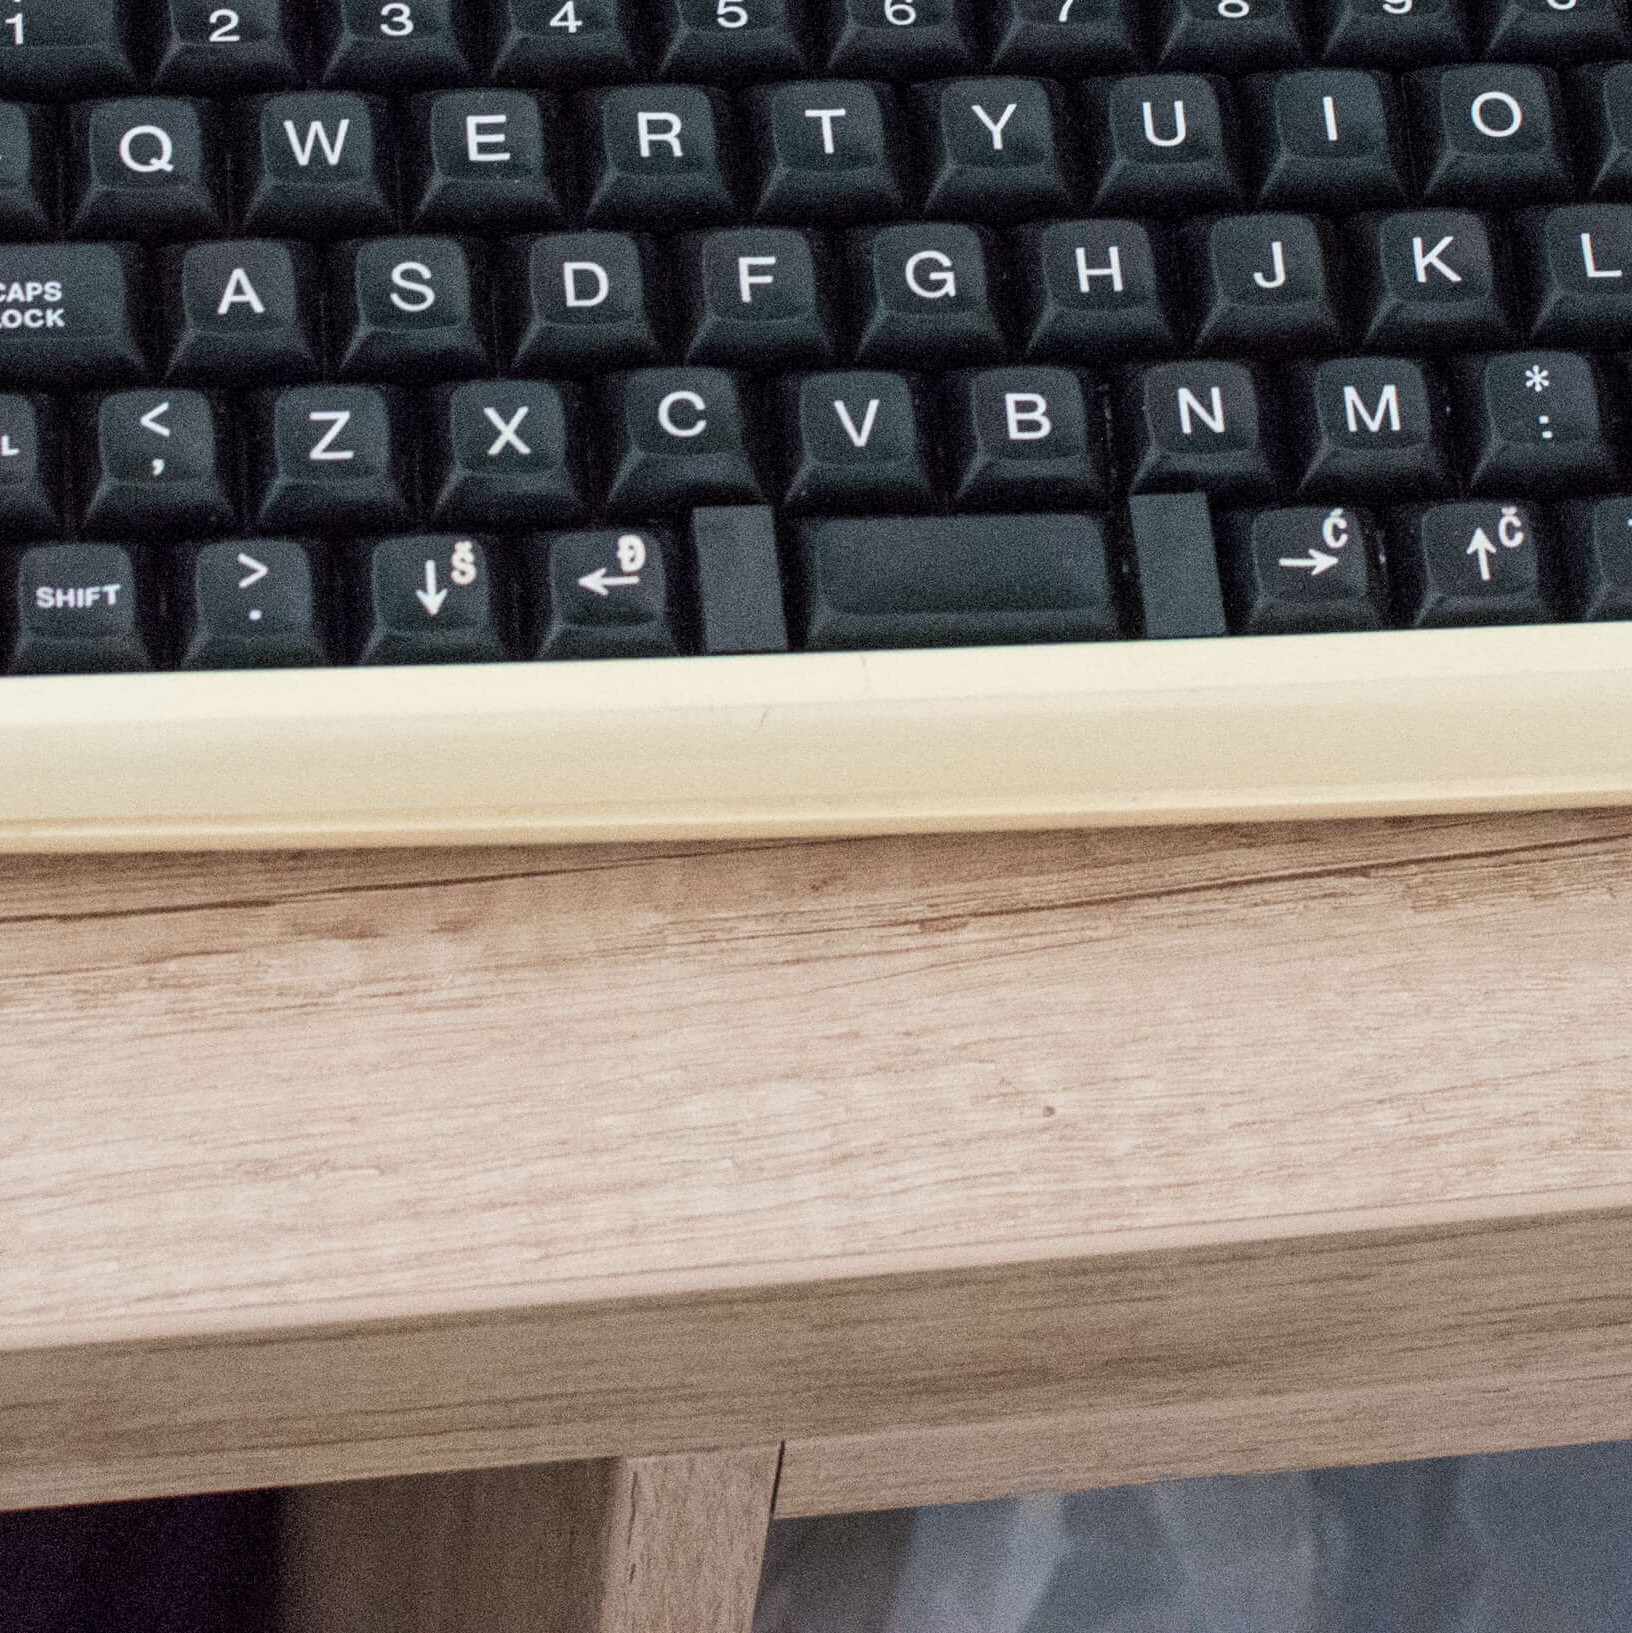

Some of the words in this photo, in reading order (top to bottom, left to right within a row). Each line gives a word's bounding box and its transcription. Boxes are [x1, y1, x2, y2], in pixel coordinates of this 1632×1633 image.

[5, 12, 24, 45] 1
[209, 8, 240, 42] 2
[380, 2, 414, 37] 3
[549, 0, 583, 33] 4
[466, 114, 511, 162] E
[637, 111, 683, 158] R
[804, 107, 847, 154] T
[971, 103, 1017, 150] Y
[1142, 100, 1187, 147] U
[1471, 90, 1523, 138] O
[119, 124, 174, 173] Q
[283, 118, 350, 166] W
[738, 255, 777, 303] F
[905, 250, 956, 299] G
[1075, 245, 1123, 293] H
[1253, 241, 1286, 289] J
[1412, 235, 1462, 283] K
[1580, 232, 1623, 278] L
[217, 267, 265, 315] A
[390, 261, 435, 312] S
[563, 261, 610, 307] D
[483, 406, 531, 455] X
[658, 390, 707, 437] C
[833, 398, 880, 447] V
[1004, 392, 1051, 440] B
[1177, 386, 1225, 434] N
[1343, 384, 1401, 432] M
[309, 410, 354, 460] Z
[1498, 507, 1524, 548] Č
[36, 583, 121, 609] SHIFT
